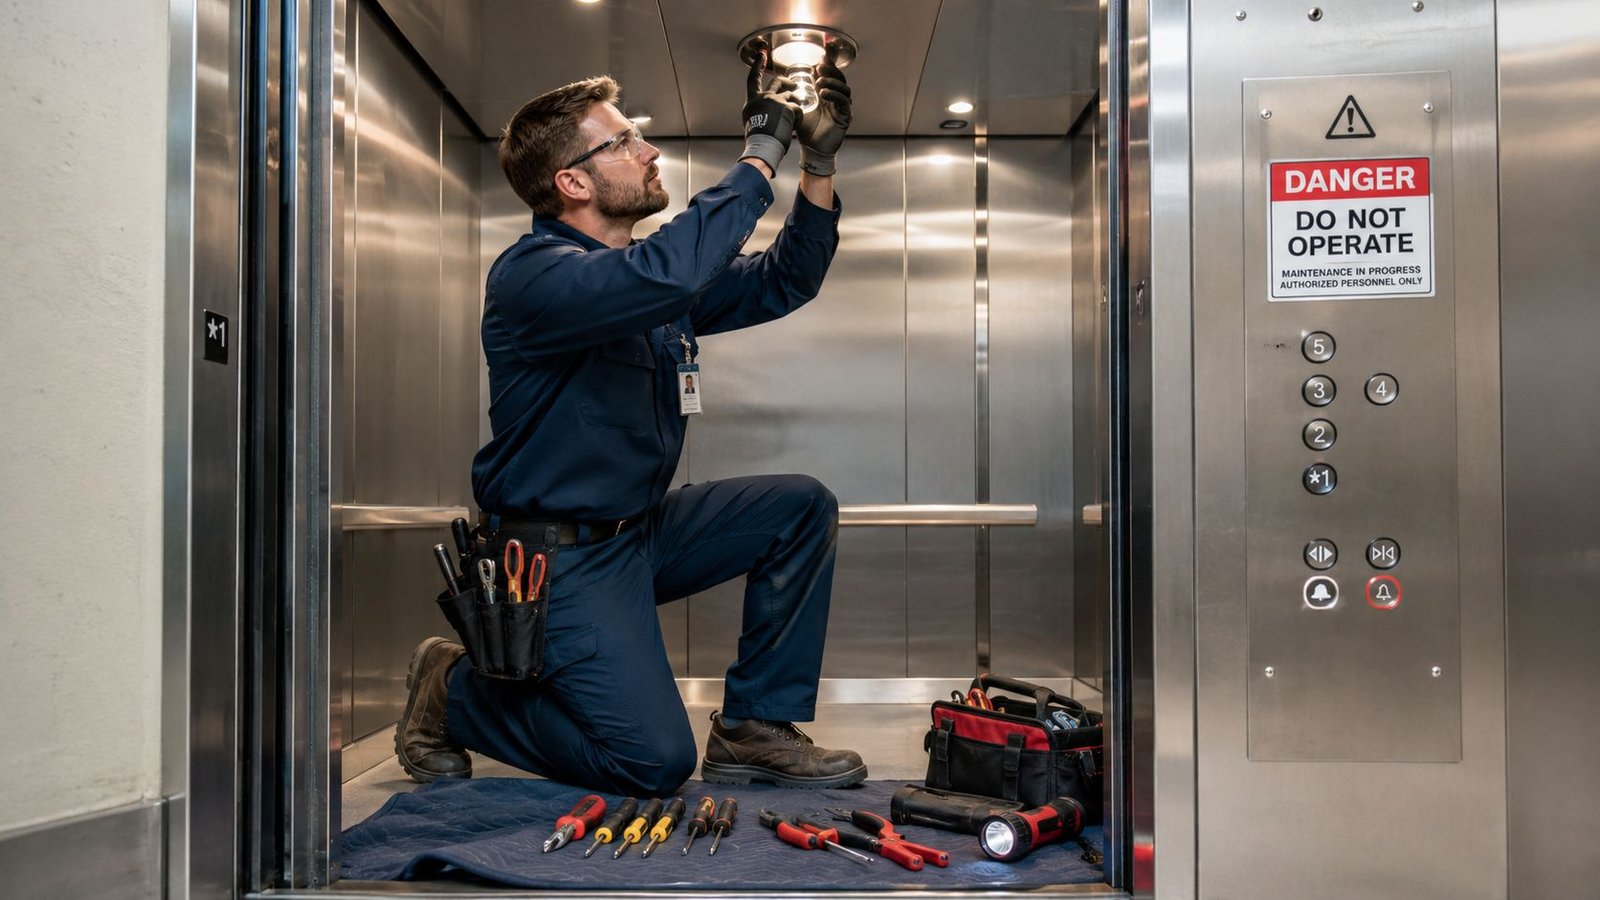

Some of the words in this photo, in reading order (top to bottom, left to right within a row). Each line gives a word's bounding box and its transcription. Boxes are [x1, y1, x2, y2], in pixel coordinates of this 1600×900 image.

[1285, 166, 1416, 194] DANGER
[1296, 209, 1336, 231] DO
[1348, 207, 1406, 229] NOT
[1288, 233, 1414, 256] OPERATE
[1281, 267, 1352, 278] MAINTENANCE
[1356, 267, 1366, 276] IN
[1369, 265, 1421, 275] PROGRESS
[1280, 279, 1338, 289] AUTHORIZED
[1341, 278, 1396, 287] PERSONNEL
[1398, 276, 1423, 285] ONLY
[1313, 339, 1325, 354] 5
[1313, 382, 1325, 398] 3
[1375, 380, 1387, 397] 4
[1314, 426, 1326, 443] 2
